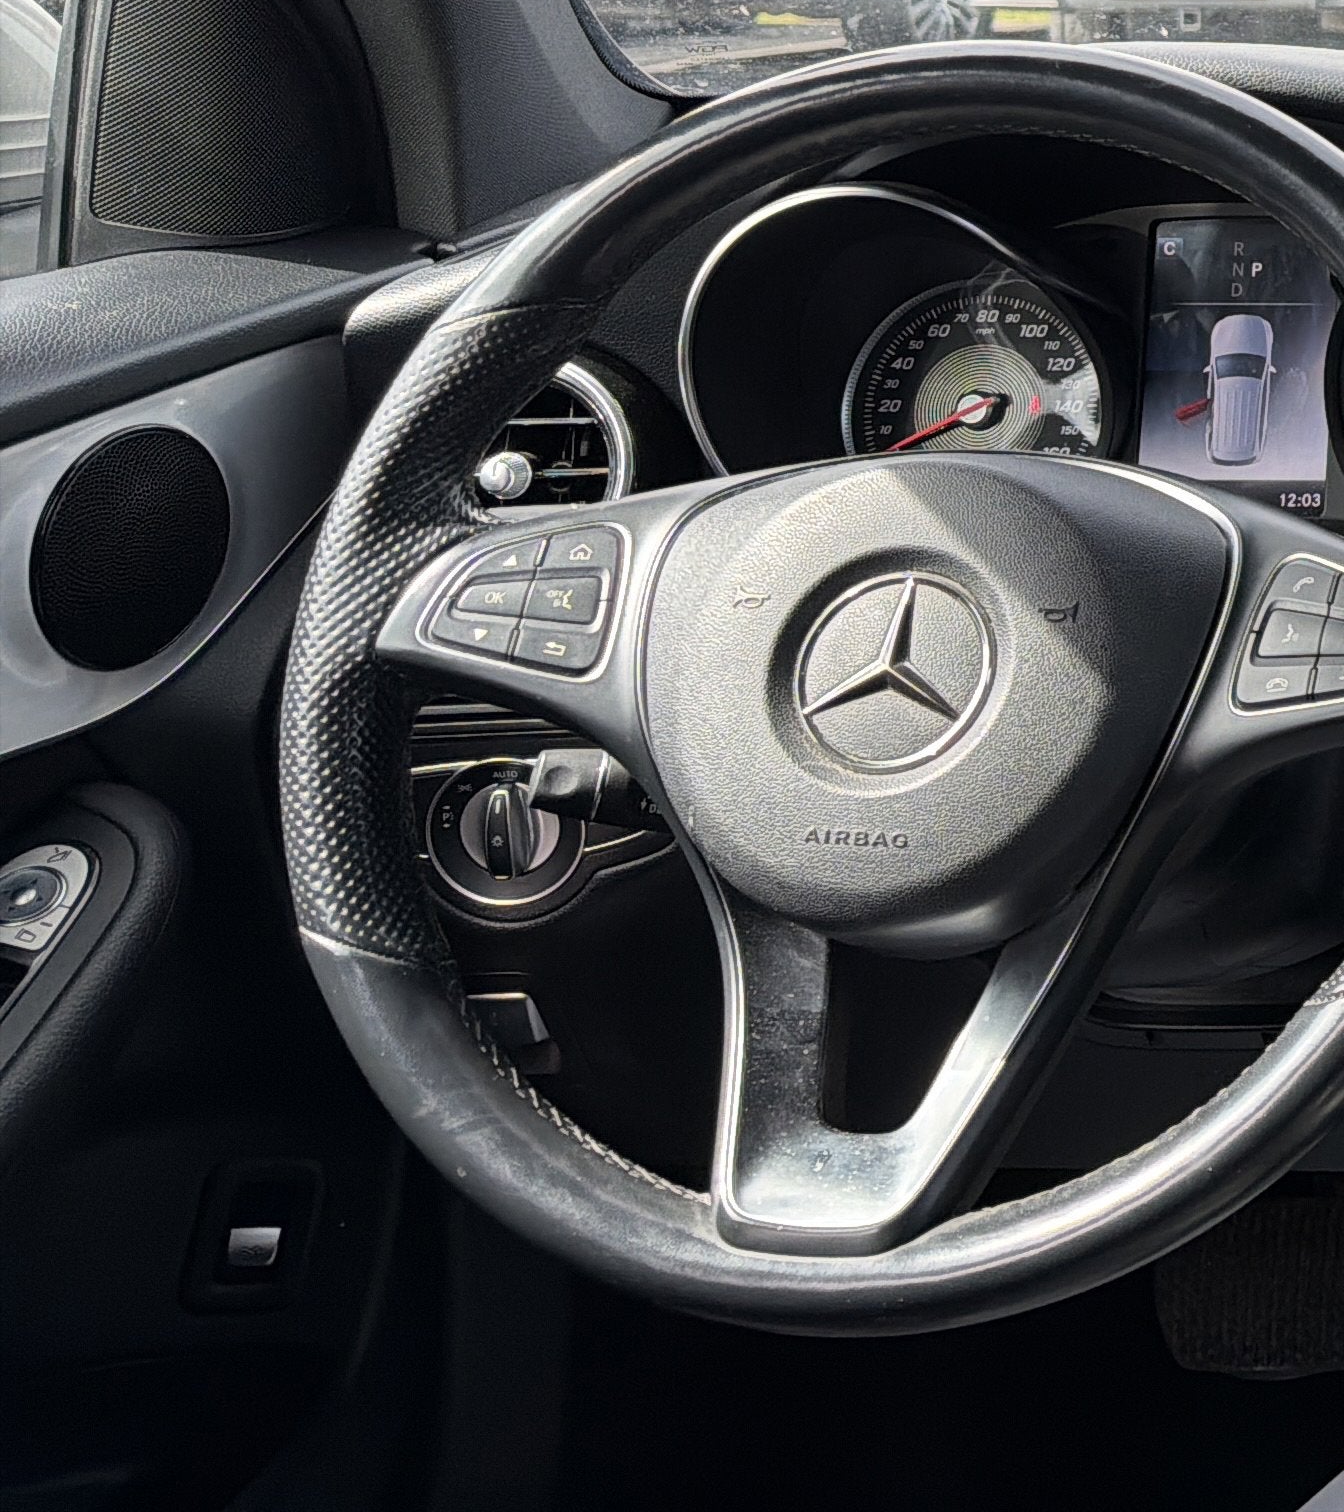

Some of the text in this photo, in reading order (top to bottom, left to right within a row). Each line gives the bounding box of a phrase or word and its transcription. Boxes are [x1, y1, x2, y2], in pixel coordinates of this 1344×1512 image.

[1163, 242, 1176, 256] C
[1234, 242, 1244, 257] R
[1233, 263, 1245, 277] N
[1251, 262, 1263, 278] P
[1231, 283, 1243, 298] D
[953, 313, 970, 323] 70
[975, 309, 1000, 323] 80
[1005, 313, 1021, 324] 90
[927, 324, 951, 338] 60
[975, 327, 996, 336] mph
[1019, 324, 1049, 338] 100
[908, 340, 925, 350] 50
[1043, 340, 1060, 351] 110
[890, 356, 915, 370] 40
[1046, 357, 1076, 372] 120
[884, 379, 900, 389] 30
[877, 399, 902, 413] 20
[1054, 399, 1084, 413] 140
[879, 425, 893, 435] 10
[1060, 425, 1080, 436] 150
[1279, 493, 1321, 508] 12:03
[484, 591, 506, 605] OK
[492, 770, 518, 779] AUTO
[804, 827, 909, 849] AIRBAG
